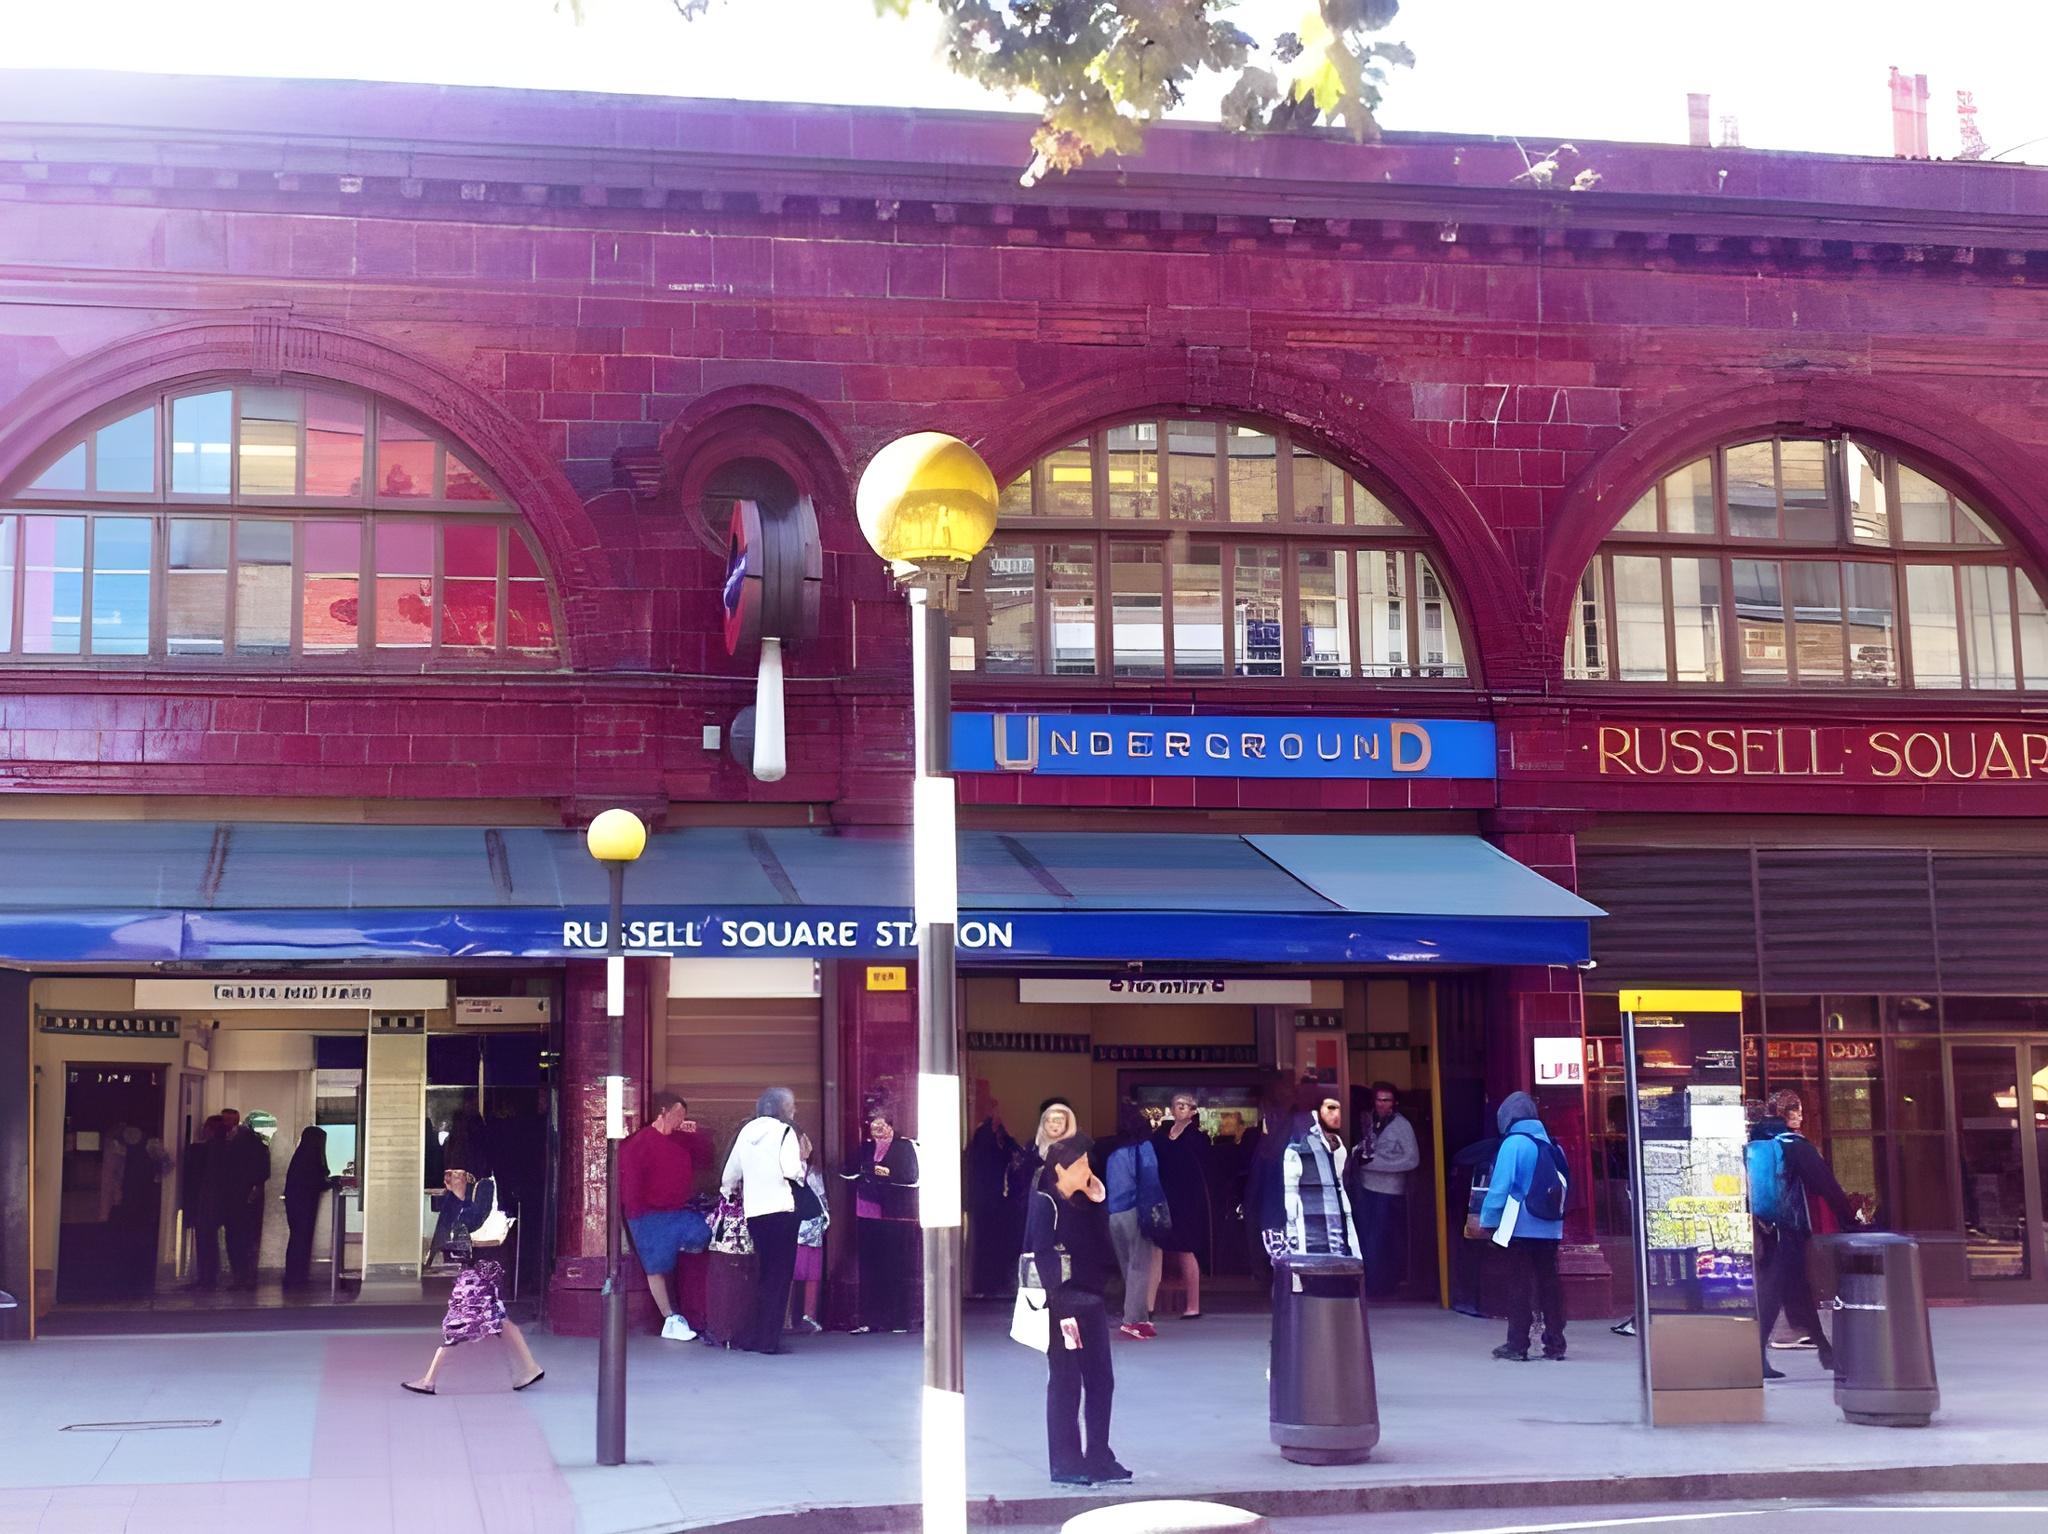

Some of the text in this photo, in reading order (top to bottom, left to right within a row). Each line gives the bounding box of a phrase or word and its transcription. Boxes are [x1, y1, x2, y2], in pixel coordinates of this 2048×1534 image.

[994, 714, 1432, 773] UNDERGROUND
[1598, 725, 1845, 776] RUSSELL
[562, 920, 703, 948] RUSELL
[720, 920, 859, 948] SQUARE
